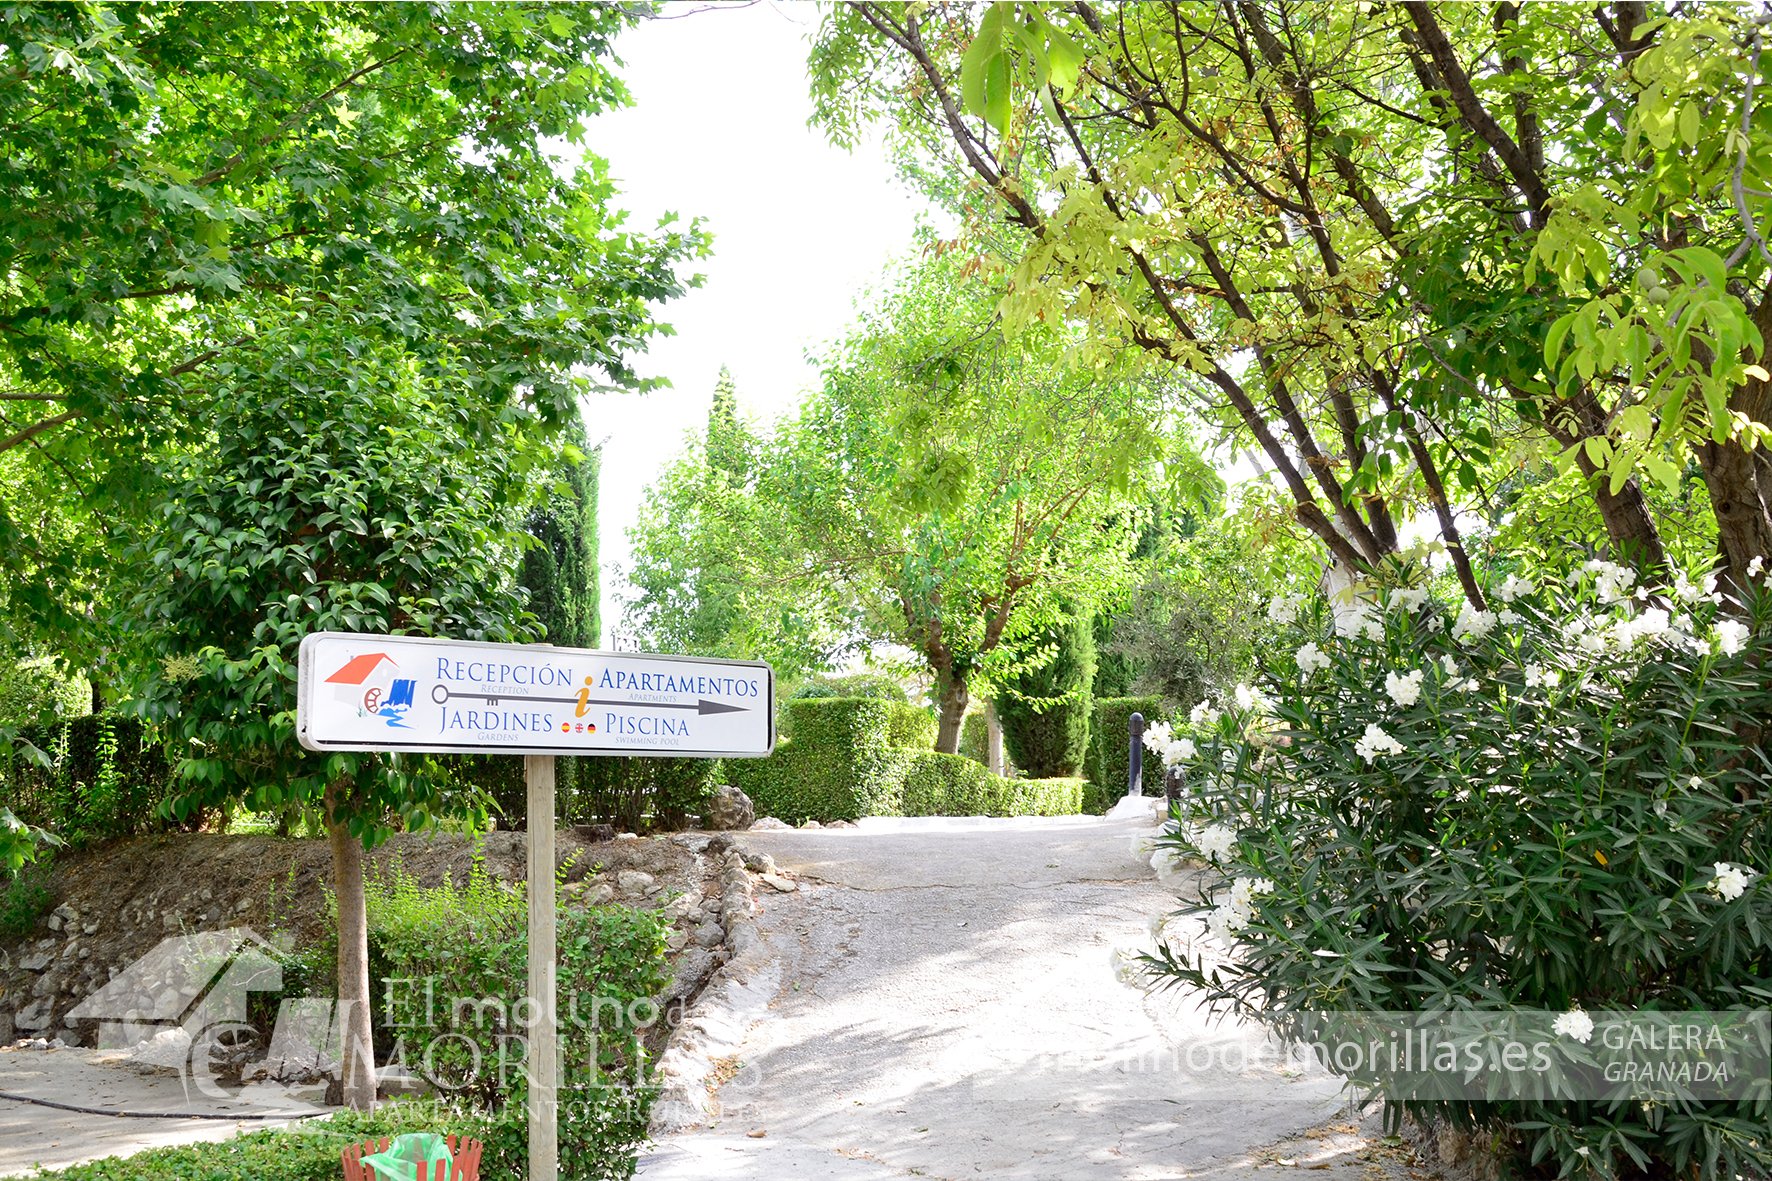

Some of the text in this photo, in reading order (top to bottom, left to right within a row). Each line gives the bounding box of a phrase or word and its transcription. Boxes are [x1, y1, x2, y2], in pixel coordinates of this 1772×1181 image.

[437, 657, 572, 687] RECEPCIÓN
[480, 683, 530, 695] RECEPTION
[599, 668, 758, 697] APARTAMENTOS
[628, 692, 678, 704] APARTMENTS
[438, 706, 553, 735] JARDINES
[605, 712, 690, 737] PISCINA
[477, 731, 519, 742] GARDENS
[615, 736, 680, 746] SWIMMING POOL
